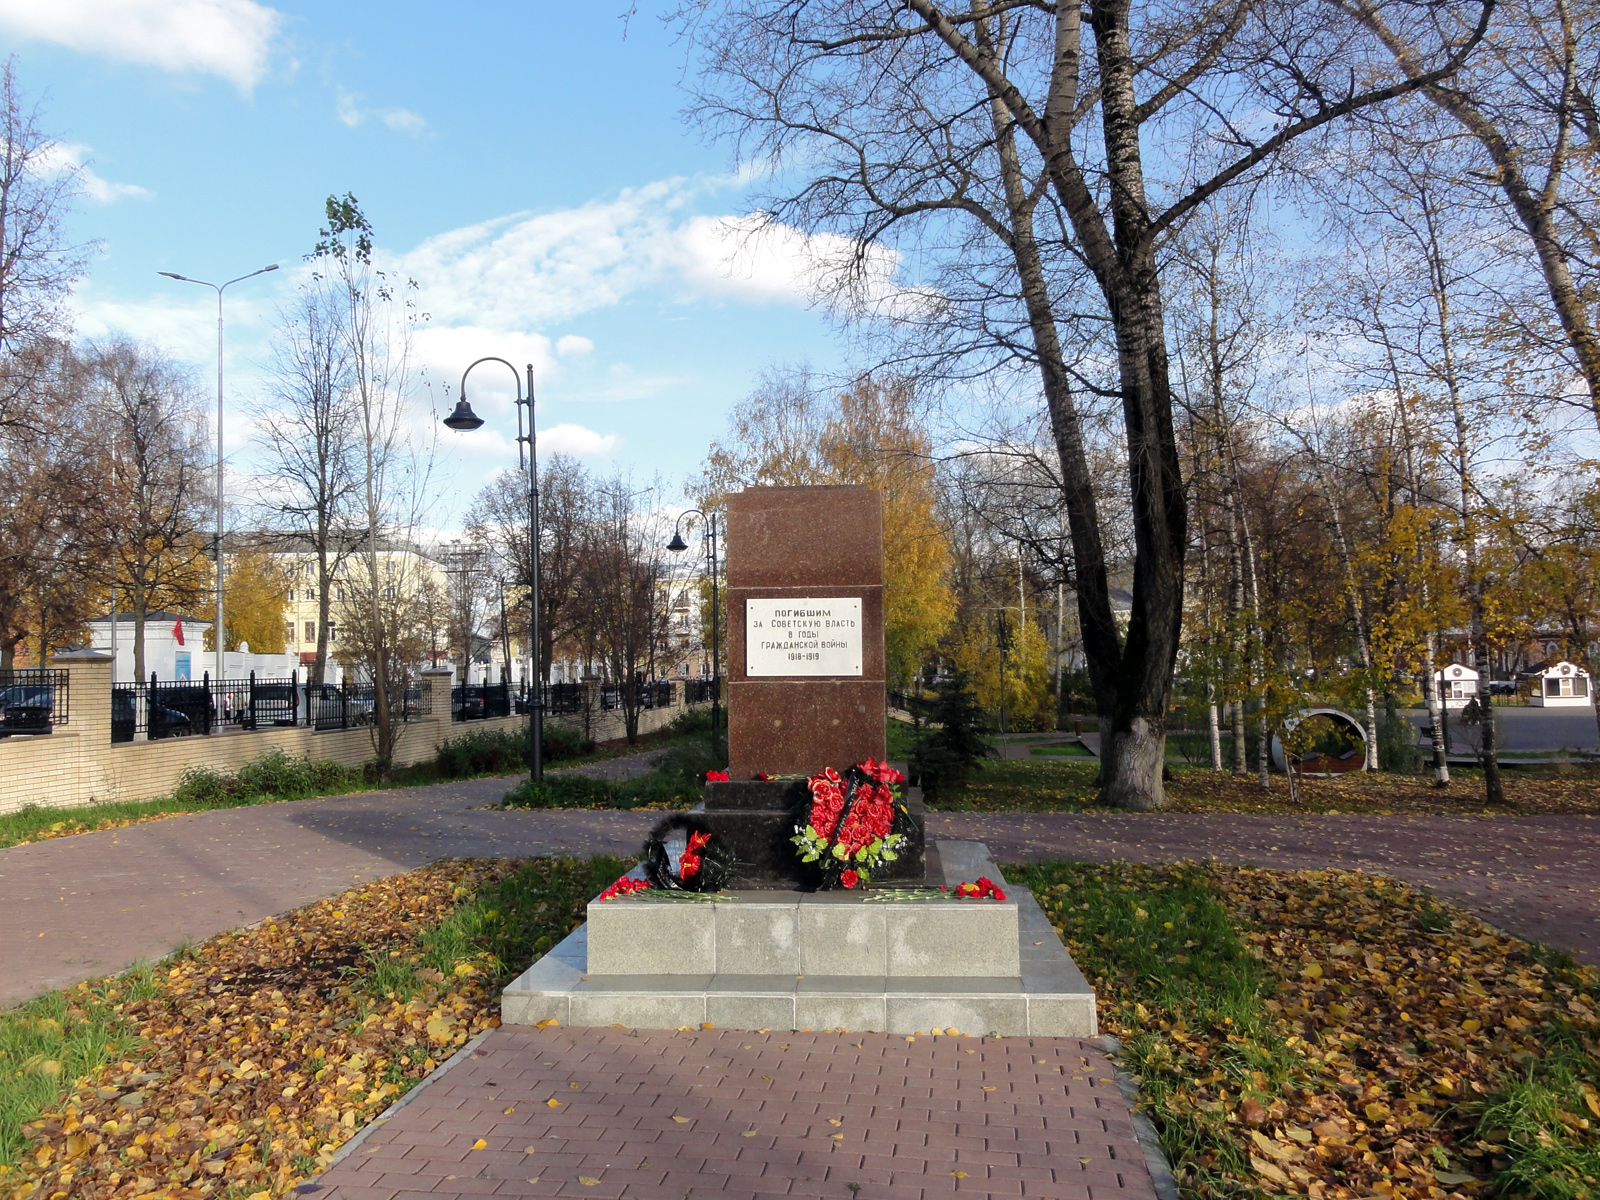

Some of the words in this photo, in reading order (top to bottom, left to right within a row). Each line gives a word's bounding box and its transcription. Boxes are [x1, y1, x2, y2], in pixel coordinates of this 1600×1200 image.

[775, 609, 831, 617] ПОГИБШИМ
[753, 620, 763, 628] ЗА
[771, 619, 821, 628] СОВЕТСКУЮ
[825, 619, 856, 628] ВЛАСТЬ
[798, 630, 819, 638] ГОДЫ
[761, 640, 819, 650] ГРАЖДАНСКОЙ
[821, 639, 848, 649] ВОЙНЫ
[788, 652, 820, 661] 1918-1919
